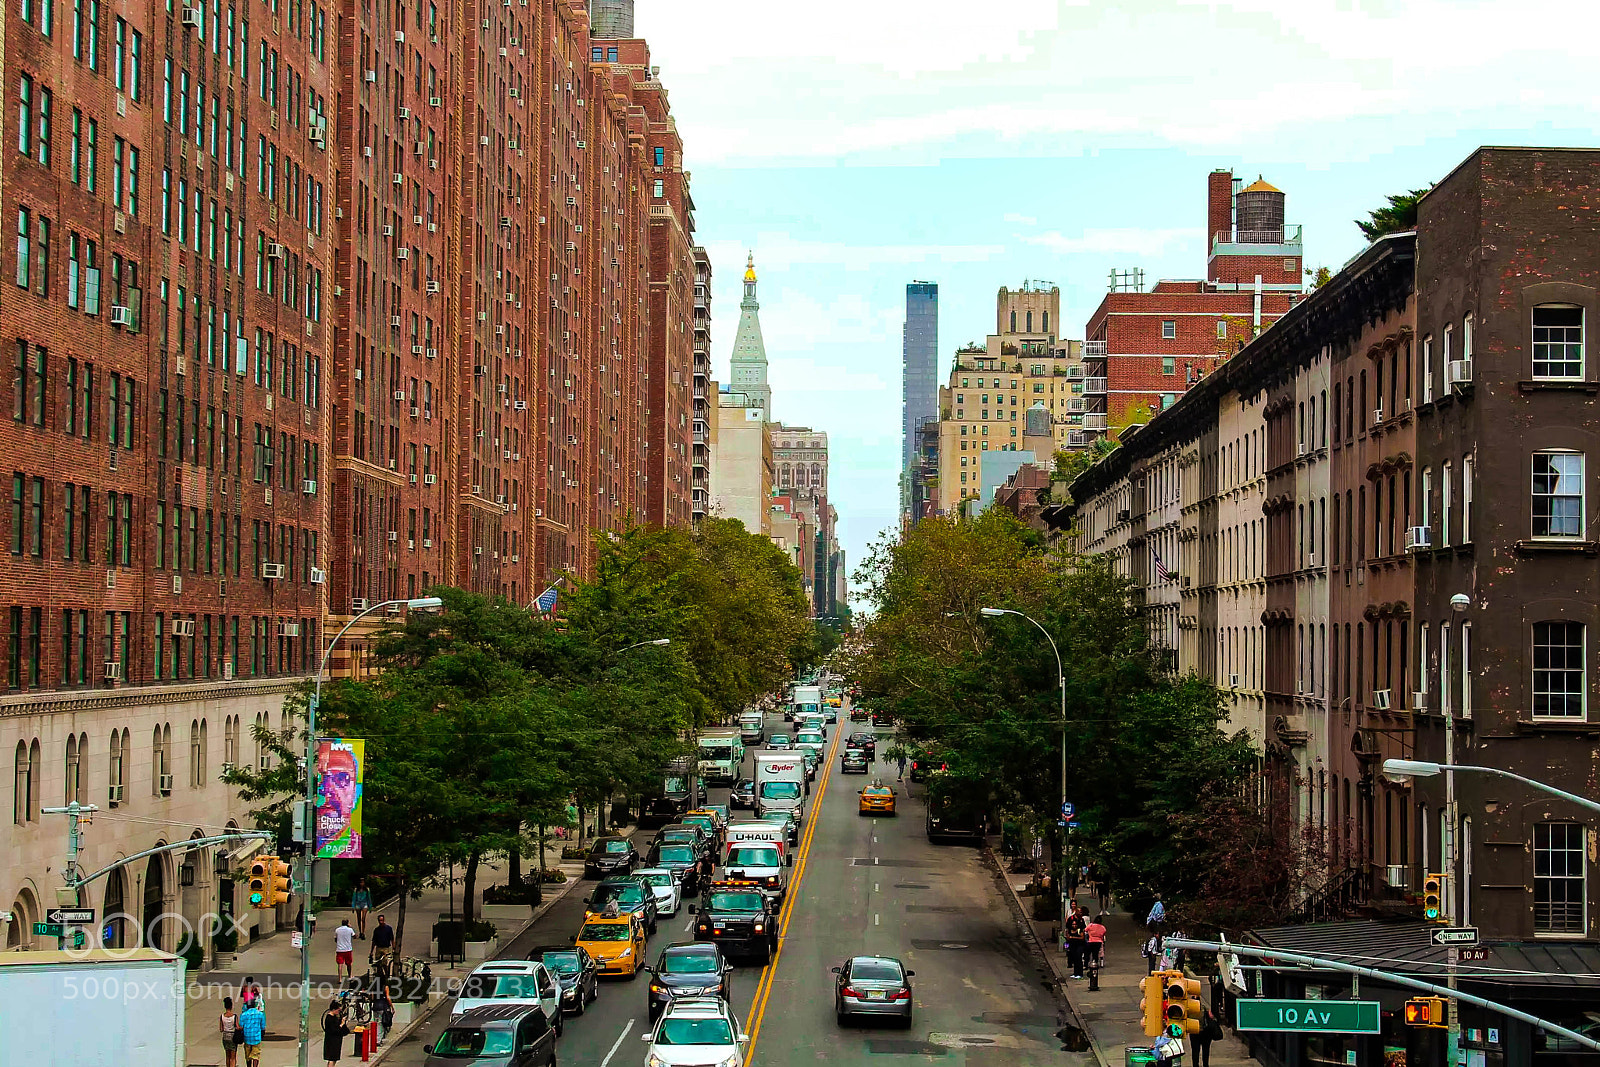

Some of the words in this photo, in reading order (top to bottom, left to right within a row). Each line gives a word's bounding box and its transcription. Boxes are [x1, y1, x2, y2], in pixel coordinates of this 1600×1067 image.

[331, 743, 353, 751] NYC
[321, 815, 346, 823] Chuck
[325, 844, 352, 853] PACE
[73, 912, 89, 920] WAY
[37, 924, 48, 934] 10
[1463, 951, 1472, 960] 10
[1474, 951, 1484, 959] Av
[1277, 1008, 1298, 1024] 10
[1303, 1008, 1331, 1024] Av
